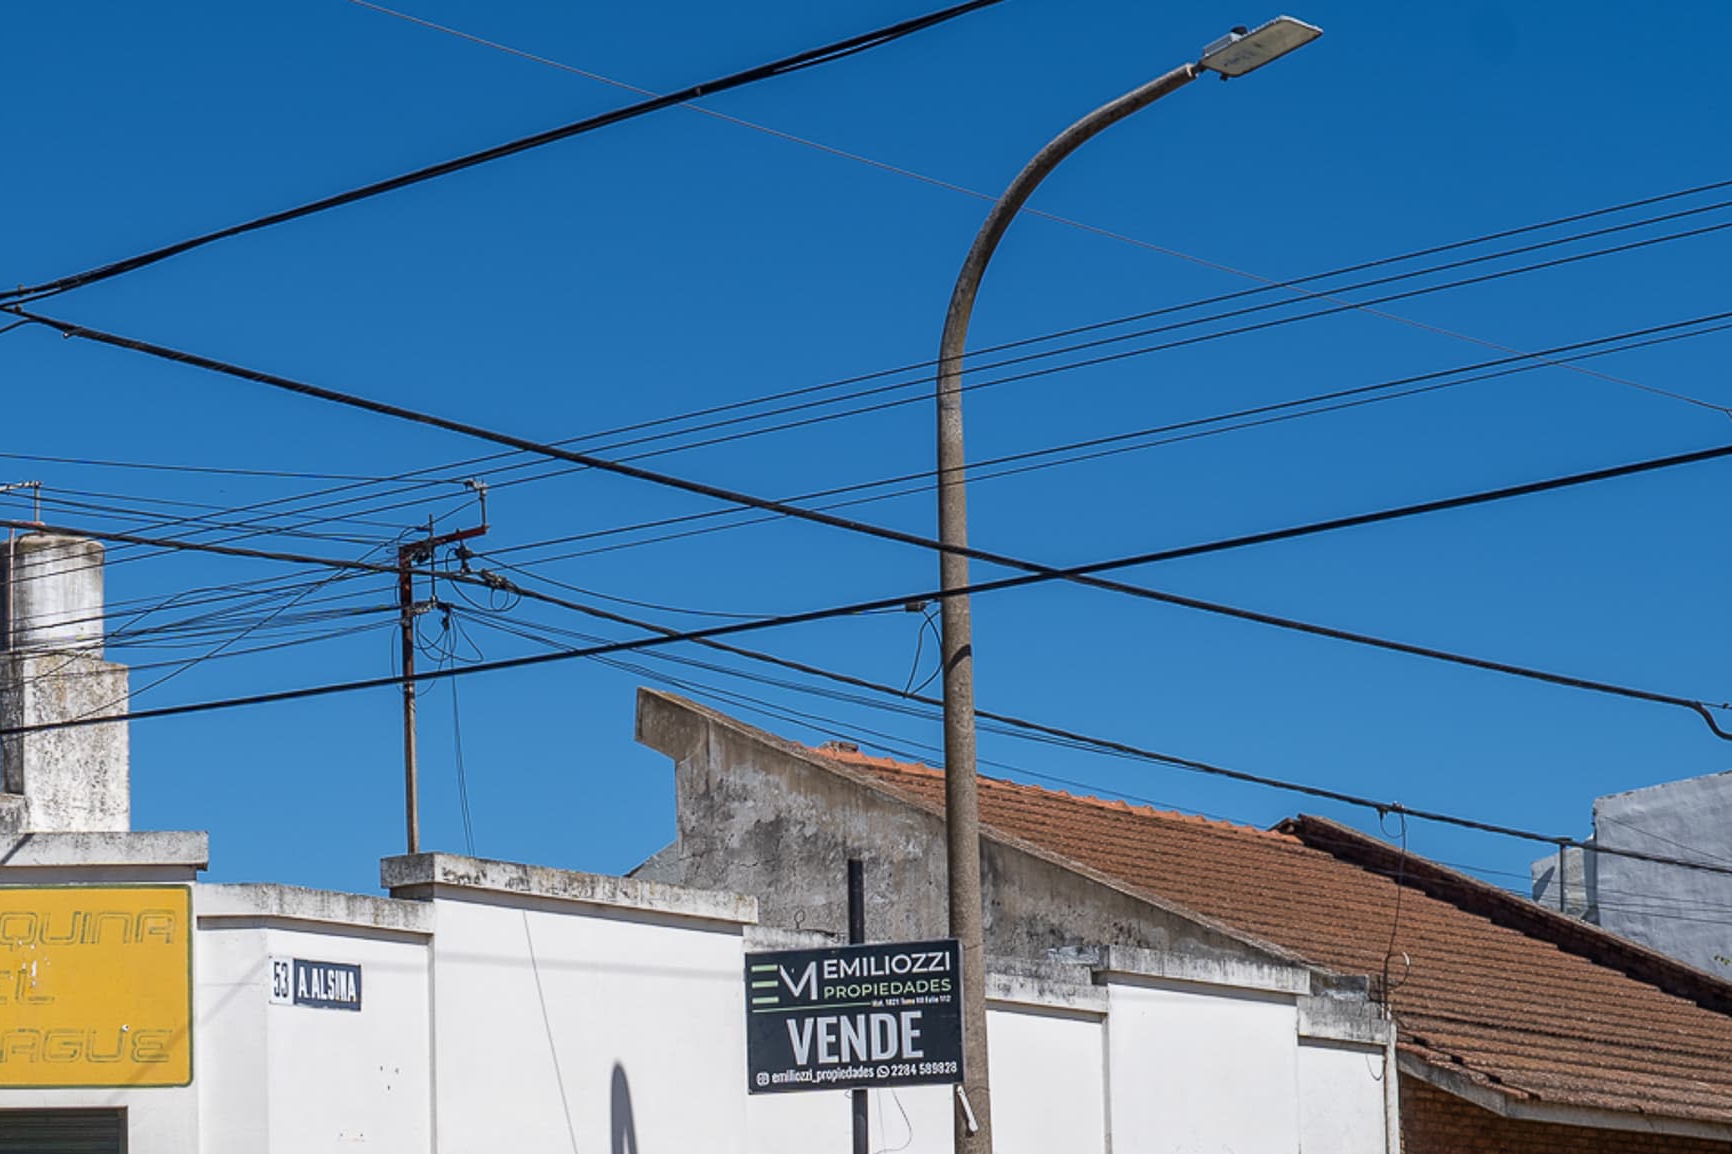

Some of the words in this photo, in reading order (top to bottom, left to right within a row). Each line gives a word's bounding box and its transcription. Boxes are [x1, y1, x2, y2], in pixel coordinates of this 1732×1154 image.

[823, 952, 951, 979] EMILIOZZI
[273, 961, 289, 998] 53
[824, 978, 952, 999] PROPIEDADES
[786, 1011, 925, 1066] VENDE
[771, 1065, 875, 1084] emiliozzi_propiedades
